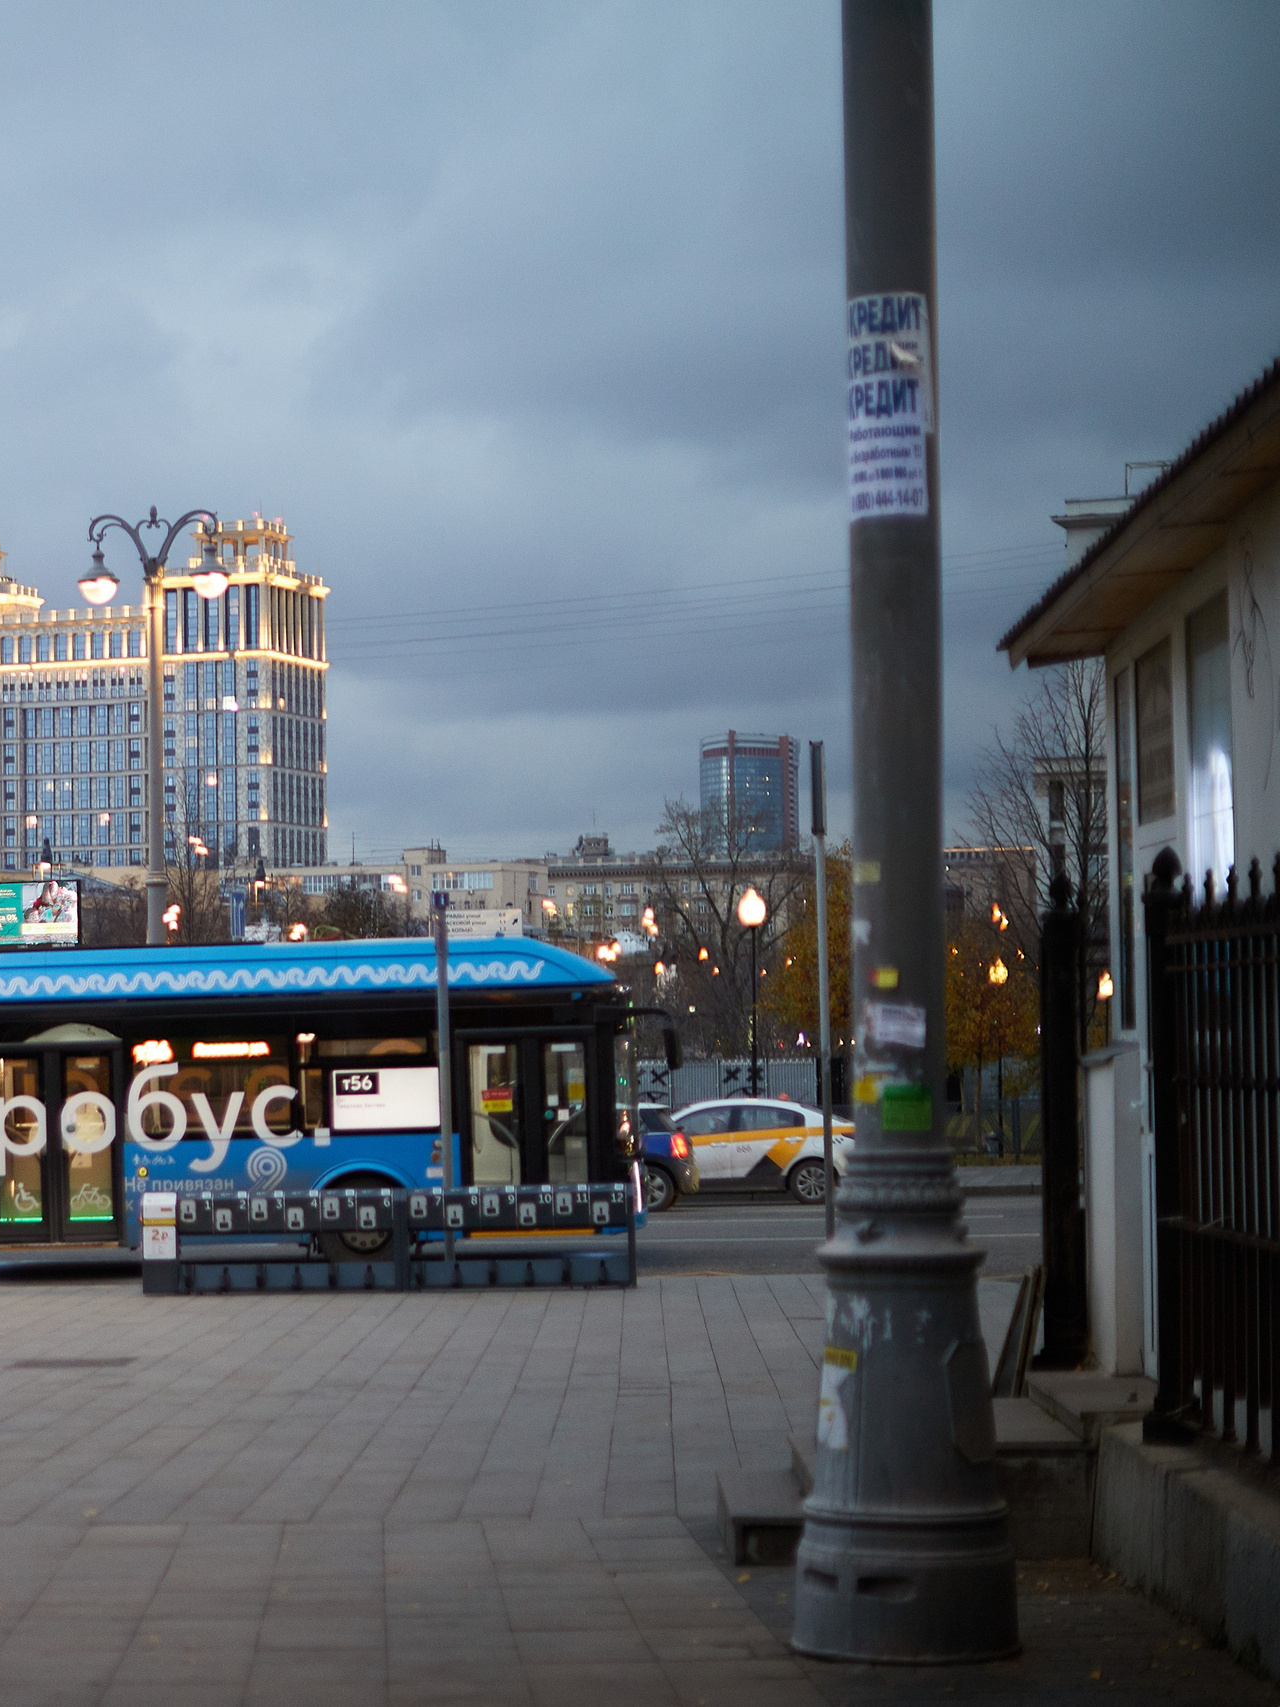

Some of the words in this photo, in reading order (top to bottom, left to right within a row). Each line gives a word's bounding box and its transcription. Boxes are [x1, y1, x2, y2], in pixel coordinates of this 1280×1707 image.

[849, 296, 921, 337] КРЕДИТ
[849, 378, 919, 421] КРЕДИТ
[342, 1075, 373, 1091] т56
[124, 1177, 146, 1192] Не
[152, 1178, 234, 1192] привязан
[310, 1199, 318, 1208] 4
[347, 1196, 354, 1207] 5
[383, 1196, 390, 1207] 6
[435, 1195, 441, 1207] 7
[470, 1195, 478, 1206] 8
[507, 1194, 515, 1205] 9
[538, 1193, 552, 1204] 10
[576, 1193, 588, 1204] 11
[611, 1192, 624, 1204] 12
[204, 1201, 210, 1211] 1
[239, 1200, 247, 1209] 2
[276, 1200, 283, 1209] 3
